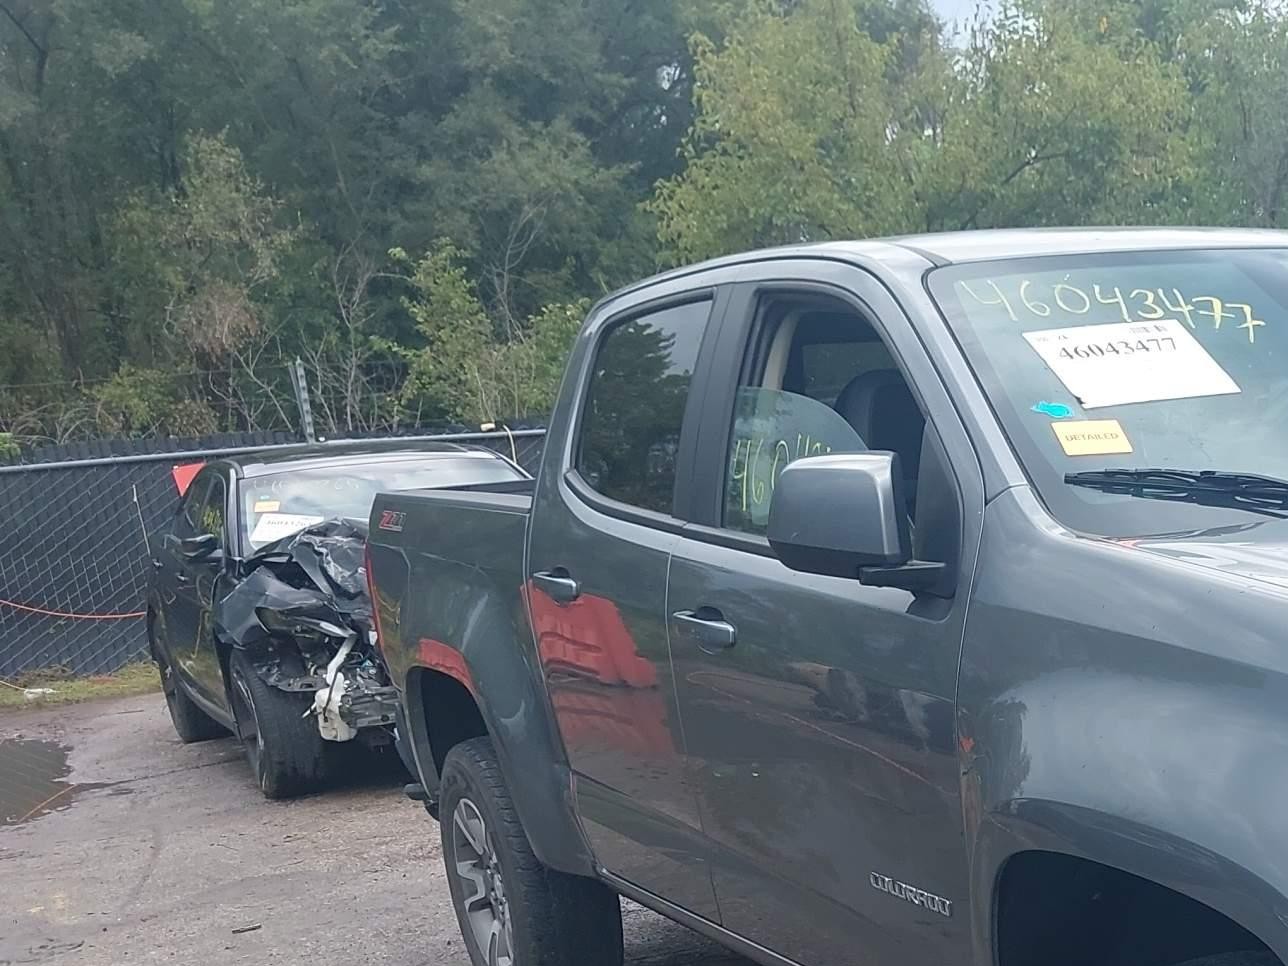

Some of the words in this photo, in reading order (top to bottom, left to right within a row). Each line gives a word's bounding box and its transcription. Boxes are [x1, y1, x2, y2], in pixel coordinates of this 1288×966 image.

[959, 274, 1266, 344] 46043477
[1058, 337, 1177, 361] 46043477
[1064, 431, 1120, 441] DETAILED
